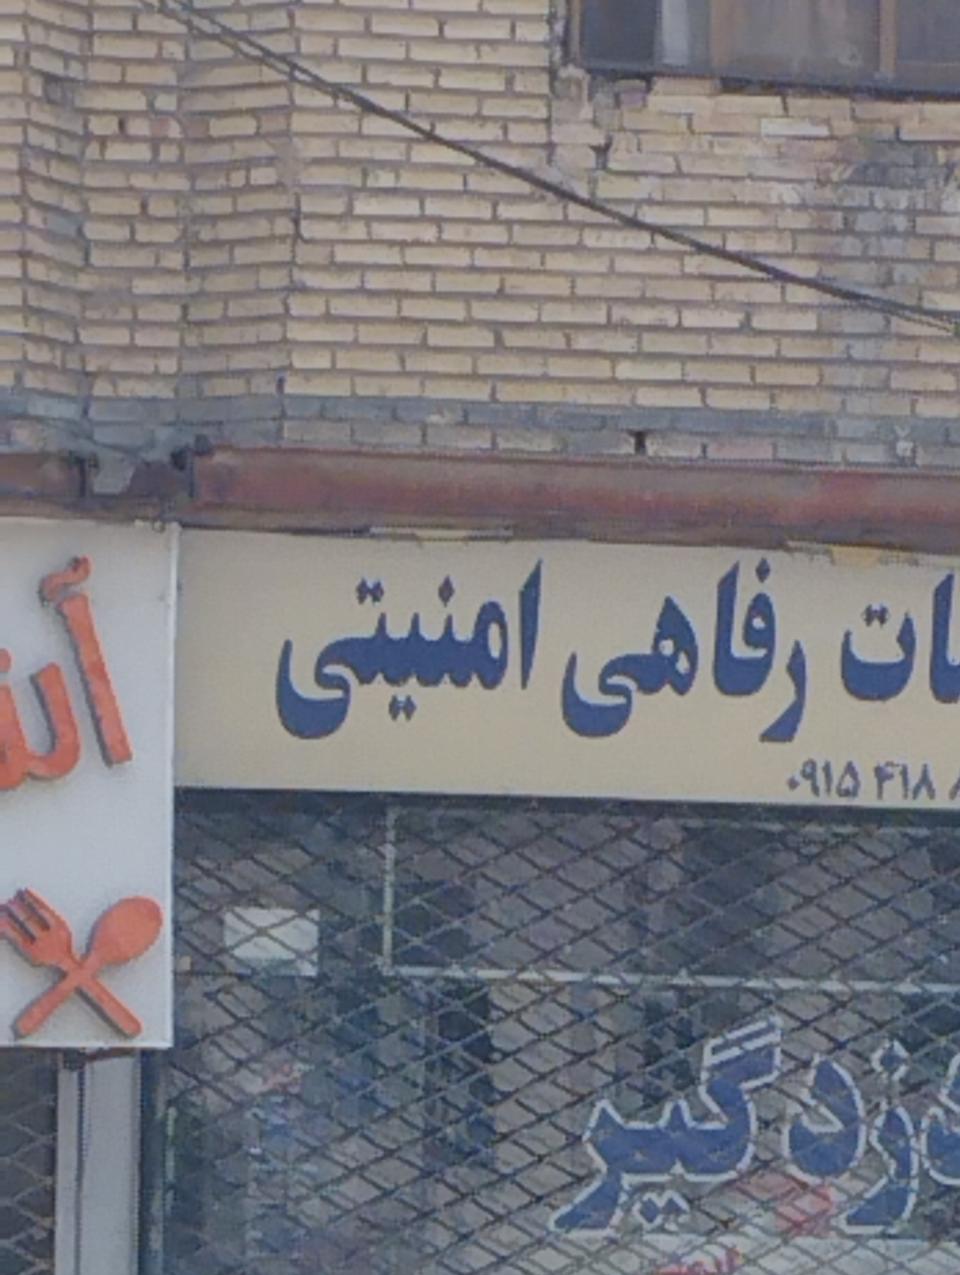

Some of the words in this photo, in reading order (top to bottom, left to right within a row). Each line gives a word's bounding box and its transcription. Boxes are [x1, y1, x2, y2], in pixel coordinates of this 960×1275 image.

[275, 558, 543, 740] امنیتی
[561, 557, 807, 742] رفاهی
[786, 758, 861, 799] ۰۹۱۵
[873, 760, 936, 801] ۴۱۸
